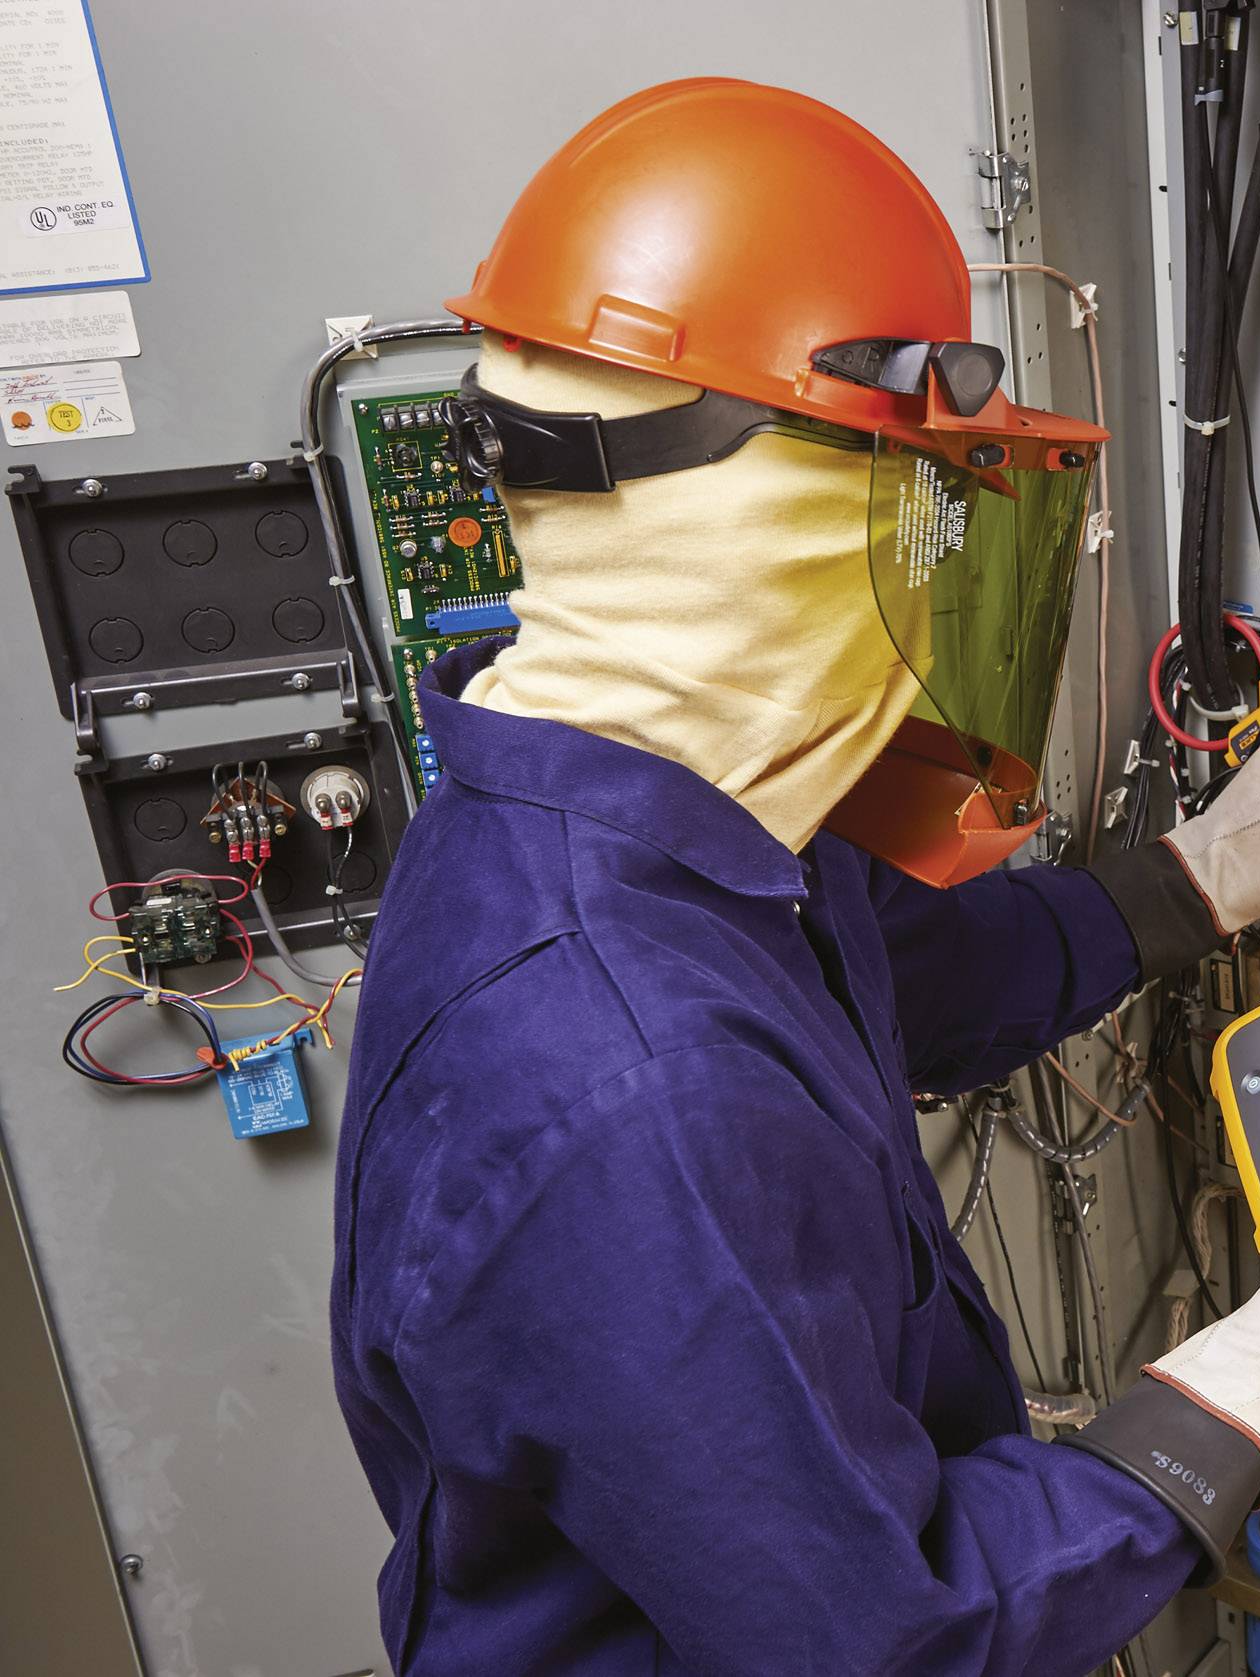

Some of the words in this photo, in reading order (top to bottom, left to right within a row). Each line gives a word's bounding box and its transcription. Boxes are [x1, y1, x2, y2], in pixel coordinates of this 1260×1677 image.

[68, 210, 96, 219] LISTED
[74, 218, 95, 227] 95M2
[58, 410, 74, 419] TEST
[951, 500, 966, 552] SALISBURY
